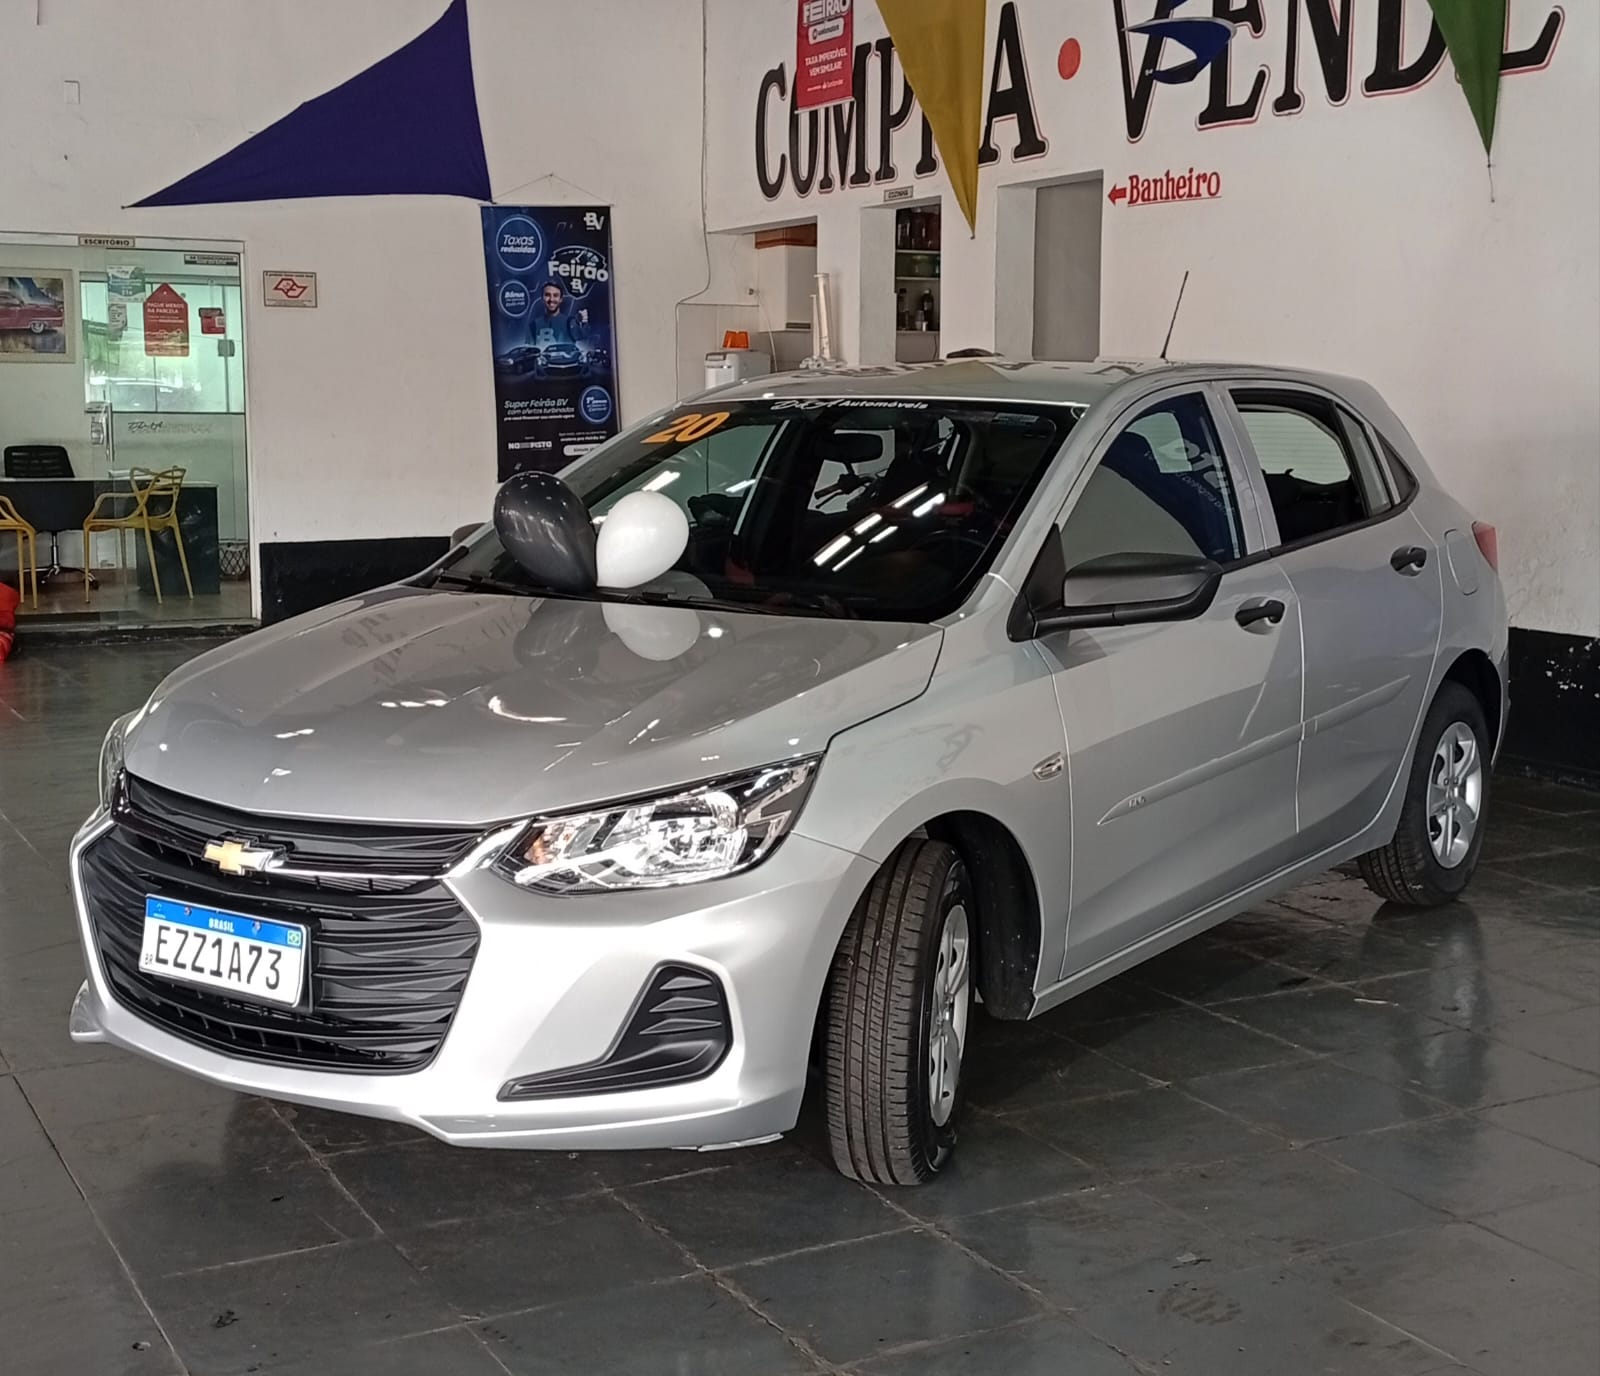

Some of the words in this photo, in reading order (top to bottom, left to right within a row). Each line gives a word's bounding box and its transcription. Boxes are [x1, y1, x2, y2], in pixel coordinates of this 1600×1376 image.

[819, 48, 847, 62] IMPERDÍVEL
[1128, 168, 1221, 205] Banheiro
[84, 238, 130, 246] ESCRITÓRIO
[503, 234, 535, 246] Taxas
[500, 245, 536, 254] reduzidas
[547, 260, 609, 282] Feirão
[504, 400, 528, 410] Super
[530, 398, 556, 408] Feirão
[557, 399, 569, 407] BV
[839, 400, 929, 409] Automóveis
[522, 408, 543, 416] ofertas
[640, 411, 731, 444] 20
[208, 917, 235, 933] BRASIL
[154, 925, 283, 990] EZZ1A73
